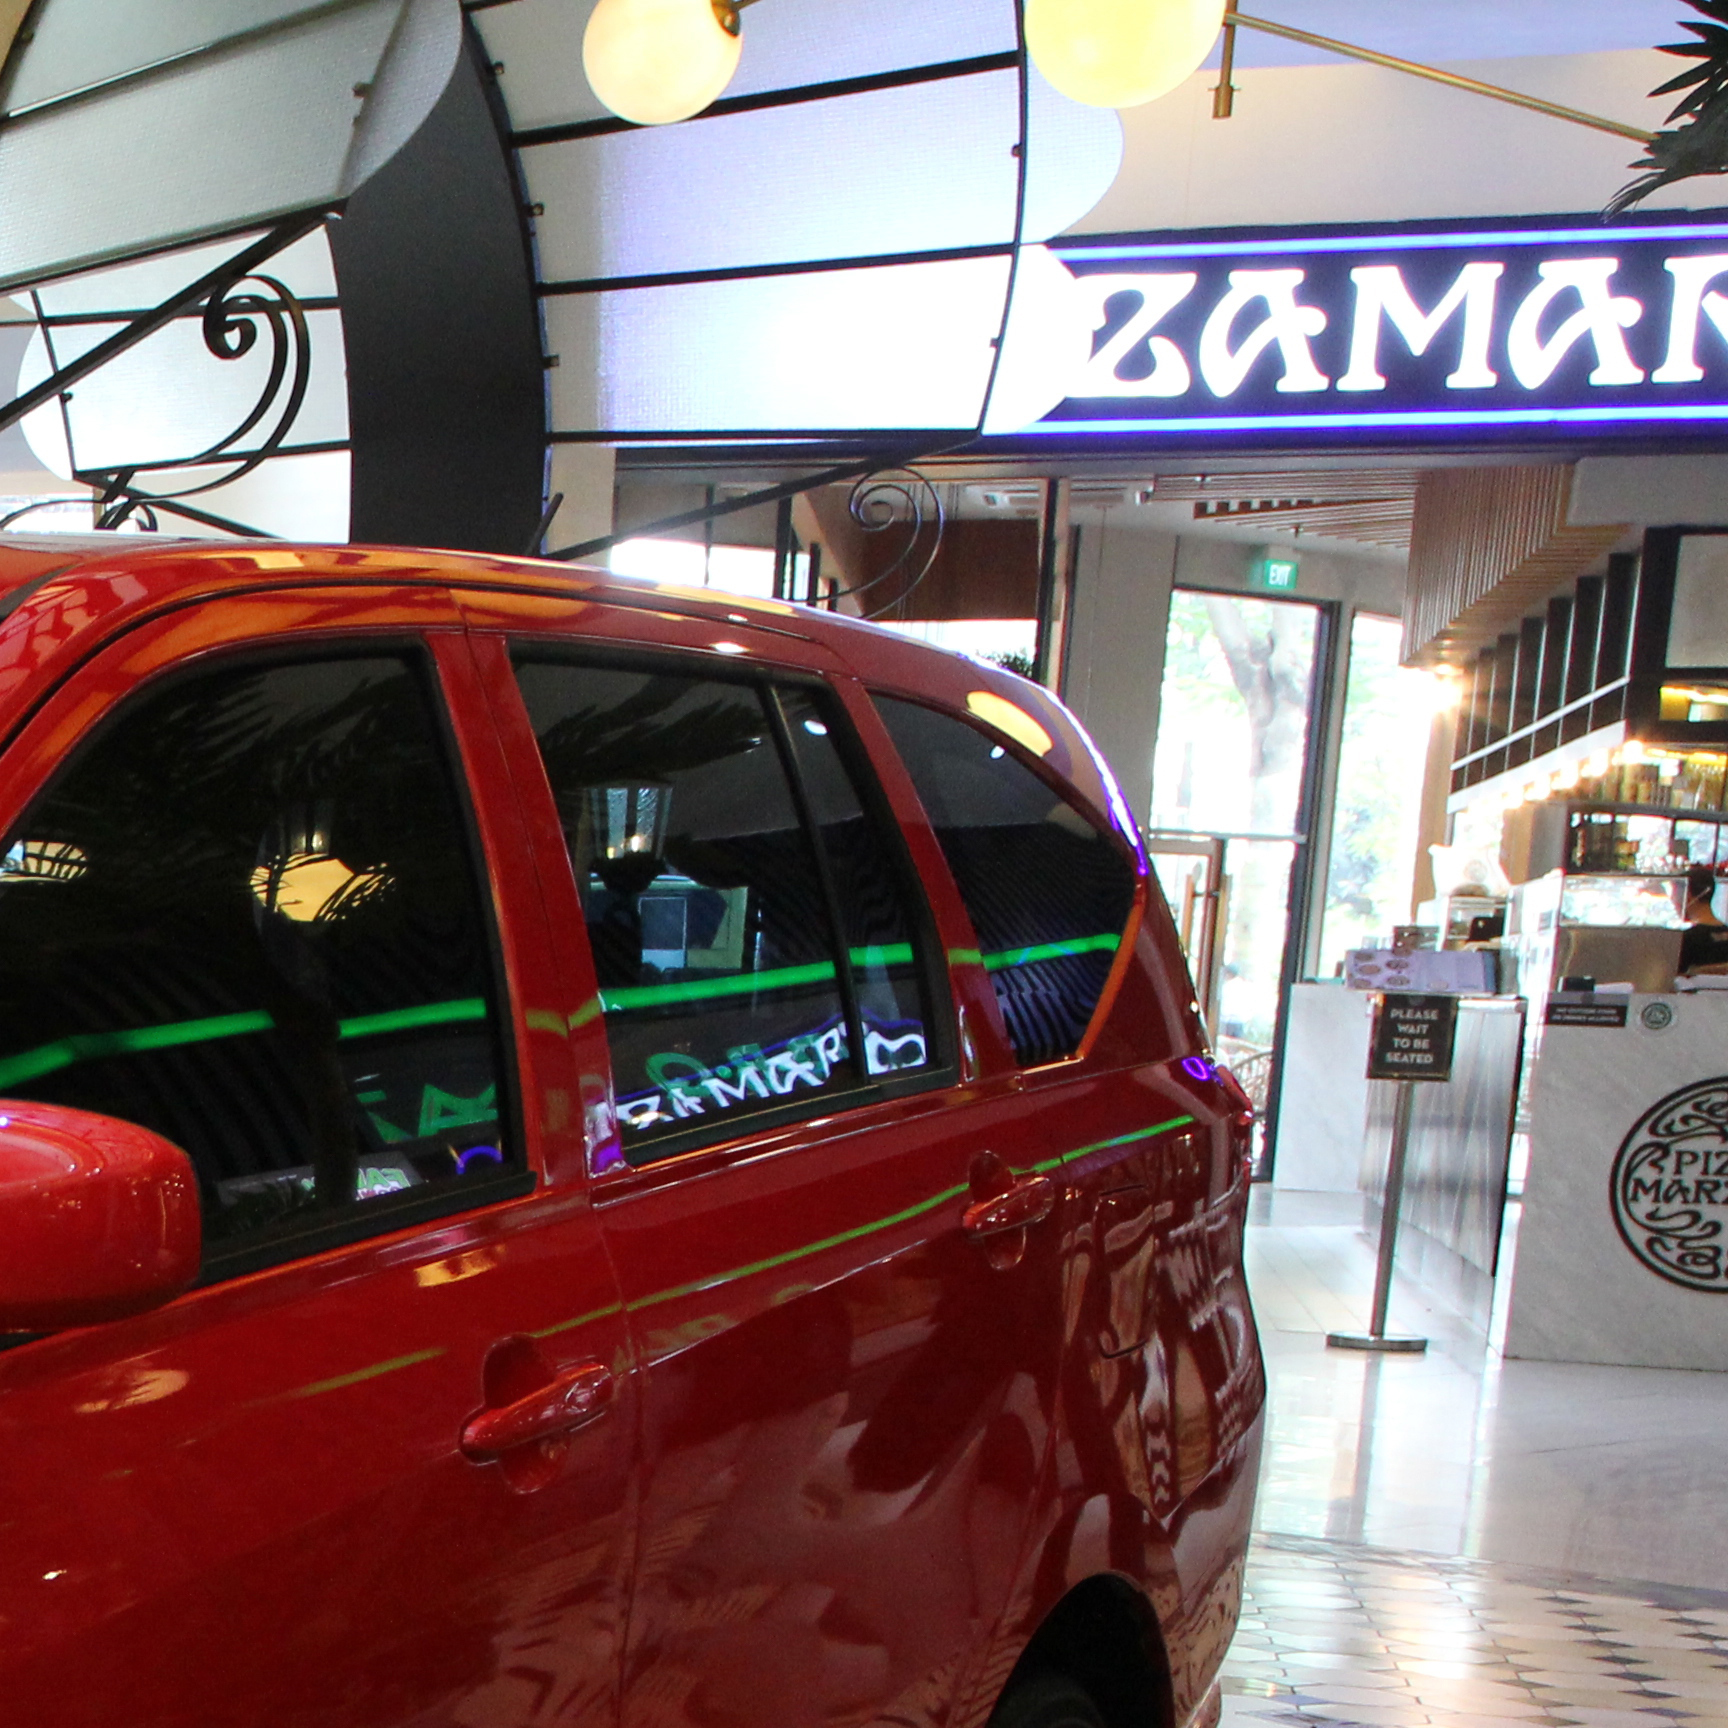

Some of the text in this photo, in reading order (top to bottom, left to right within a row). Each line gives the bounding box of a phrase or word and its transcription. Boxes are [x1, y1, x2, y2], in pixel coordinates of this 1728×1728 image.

[1390, 1008, 1440, 1021] PLEASE
[1397, 1023, 1429, 1035] WAIT
[1393, 1037, 1431, 1049] TO BE
[1385, 1051, 1434, 1064] SEATED
[1629, 1177, 1728, 1205] MAR
